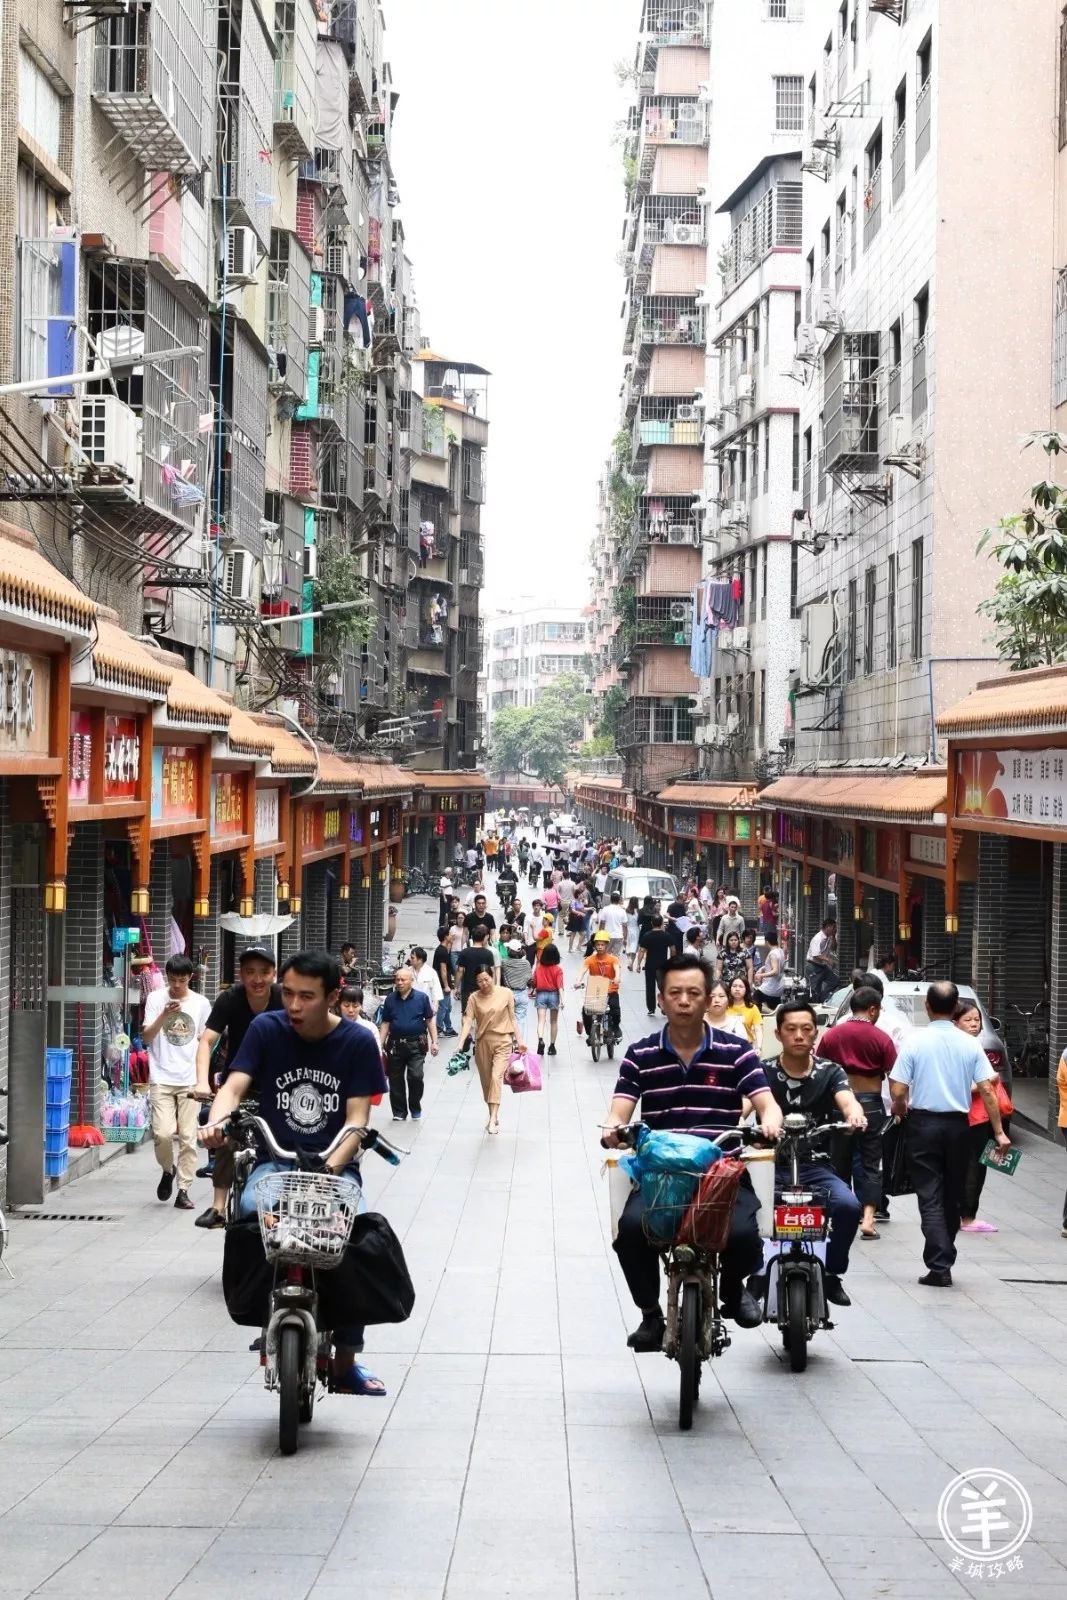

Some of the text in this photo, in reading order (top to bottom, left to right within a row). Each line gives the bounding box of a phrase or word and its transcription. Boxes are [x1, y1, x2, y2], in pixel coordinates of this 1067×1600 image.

[276, 1091, 340, 1112] 19 90
[784, 1213, 815, 1226] 台铃
